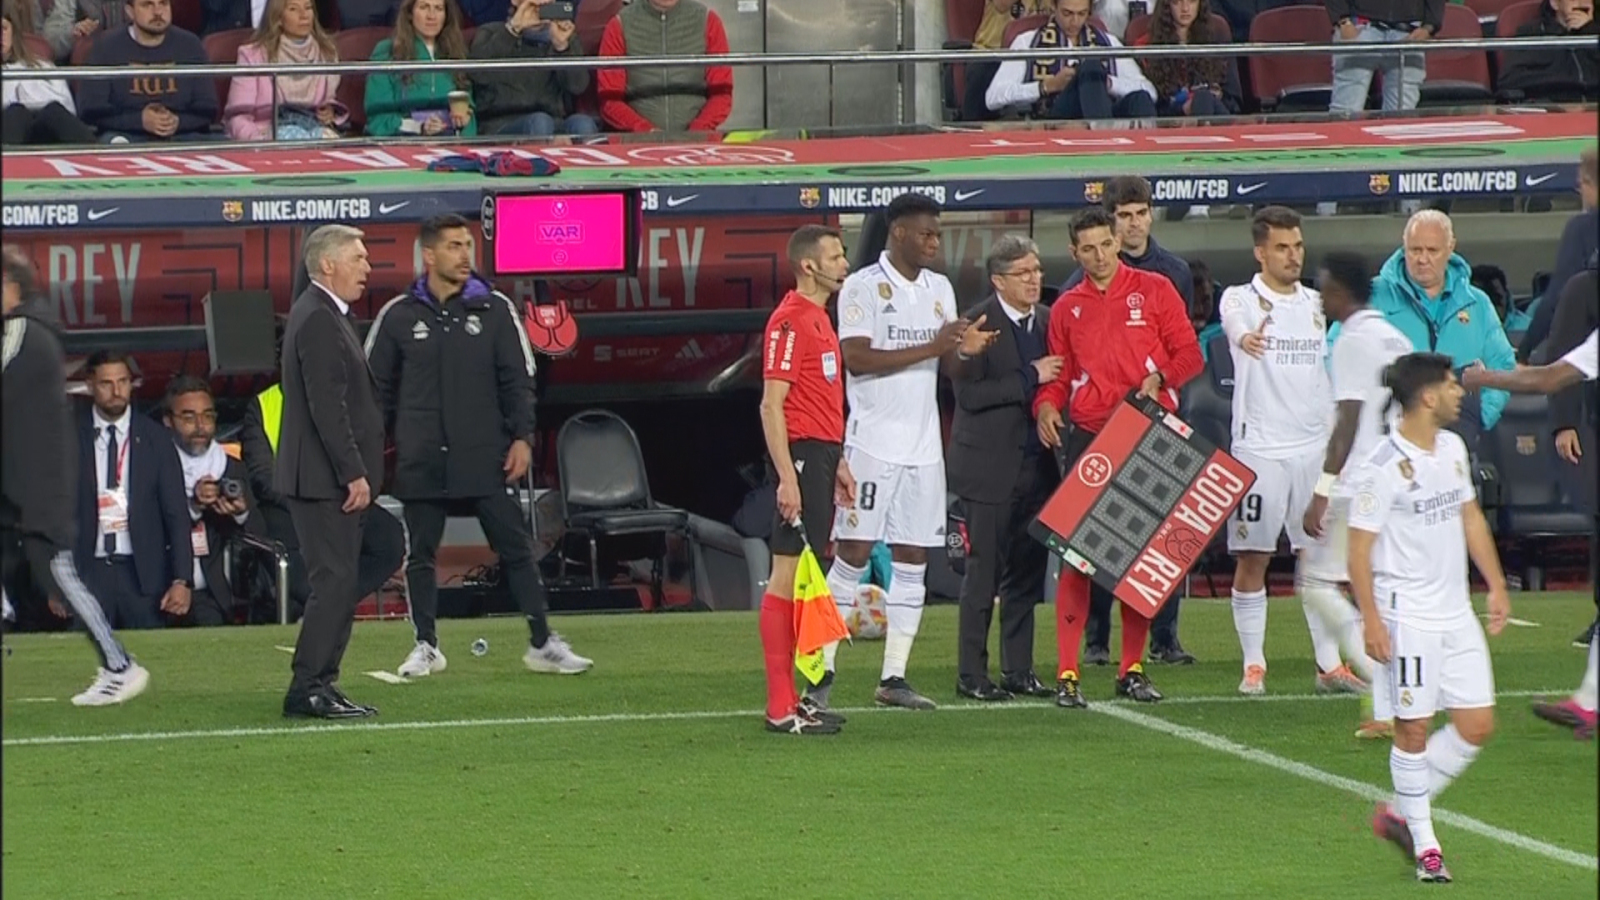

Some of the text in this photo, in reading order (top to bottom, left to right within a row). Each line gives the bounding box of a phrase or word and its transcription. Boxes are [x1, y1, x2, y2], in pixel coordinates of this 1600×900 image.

[1398, 171, 1517, 193] NIKE.COM/FCB
[251, 198, 371, 221] NIKE.COM/FCB
[541, 226, 579, 238] VAR
[48, 242, 141, 325] REY
[1173, 461, 1244, 536] COPA
[1236, 493, 1263, 522] 19
[1125, 547, 1182, 607] REY
[1397, 656, 1424, 688] 11
